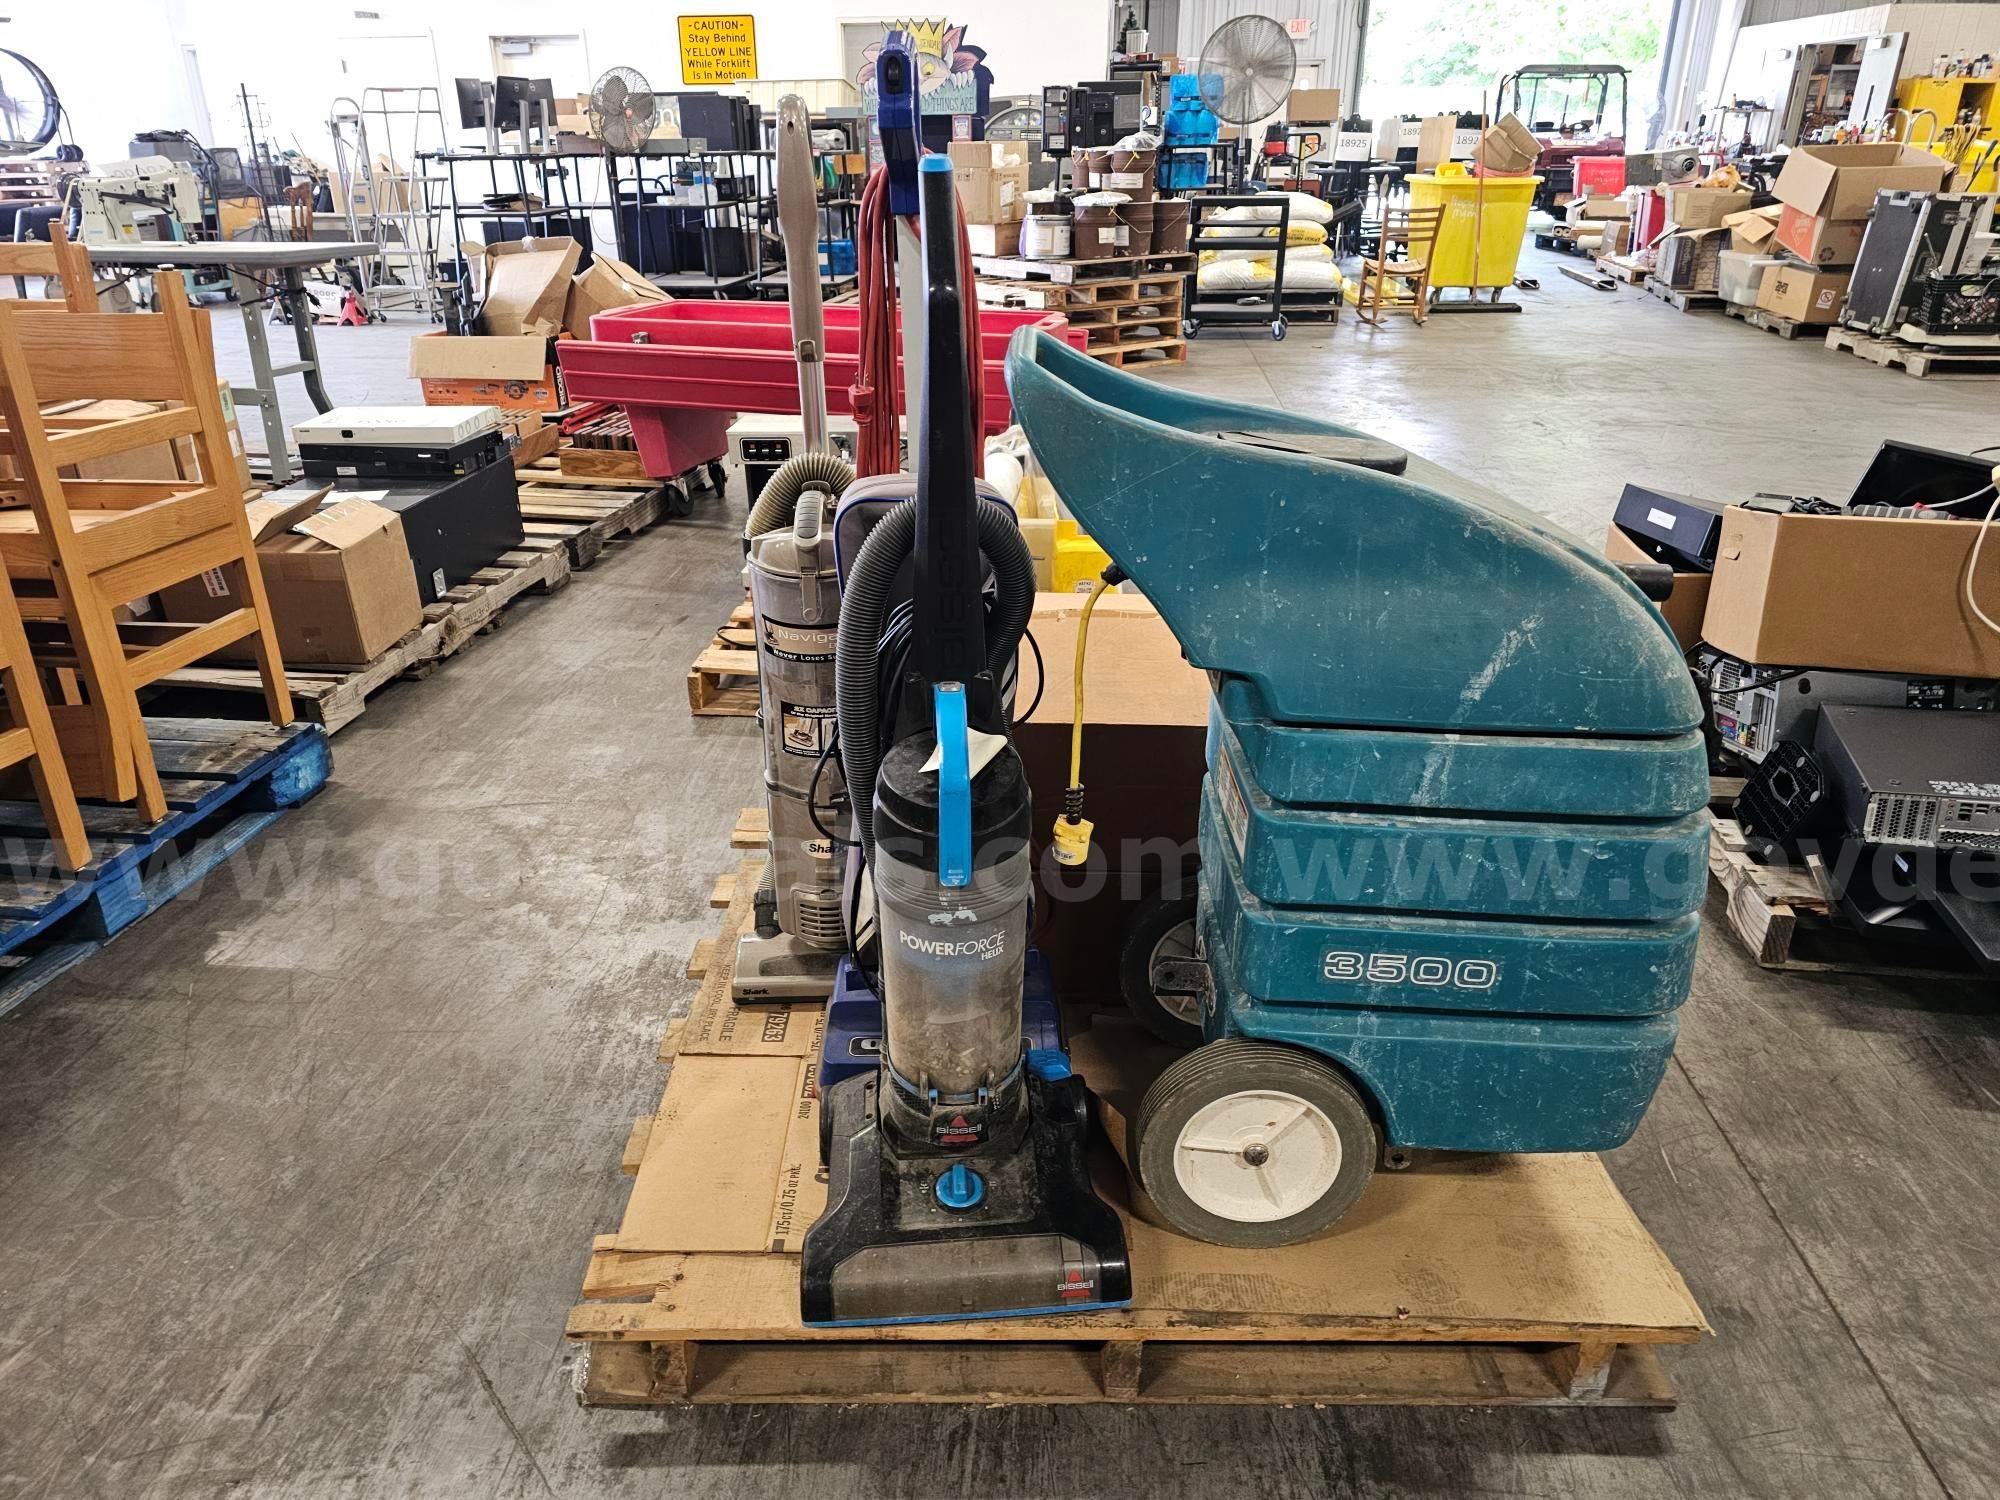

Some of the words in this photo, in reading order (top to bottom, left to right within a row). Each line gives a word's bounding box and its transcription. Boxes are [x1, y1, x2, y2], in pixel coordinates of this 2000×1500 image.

[1291, 20, 1306, 32] EXIT
[689, 34, 710, 45] Stay
[714, 33, 746, 42] Behind
[685, 47, 726, 57] YELLOW
[730, 47, 752, 56] LINE
[688, 59, 713, 68] While
[716, 58, 751, 68] Forklift
[693, 71, 701, 80] Is
[704, 71, 713, 79] In
[715, 70, 747, 79] Motion
[931, 97, 959, 113] THINGS
[959, 96, 975, 112] ARE
[1340, 138, 1367, 148] 18925
[1456, 135, 1479, 145] 1892
[778, 629, 838, 644] Naviga
[773, 648, 798, 660] Never
[981, 944, 1004, 961] HELIX
[720, 964, 731, 979] KEEP
[1324, 951, 1497, 989] 3500
[718, 981, 728, 990] IN
[707, 1006, 719, 1021] DRY
[699, 1020, 714, 1041] PLACE
[719, 1006, 740, 1042] FRAGILE
[764, 1012, 788, 1041] 79263
[798, 1101, 812, 1119] 24100
